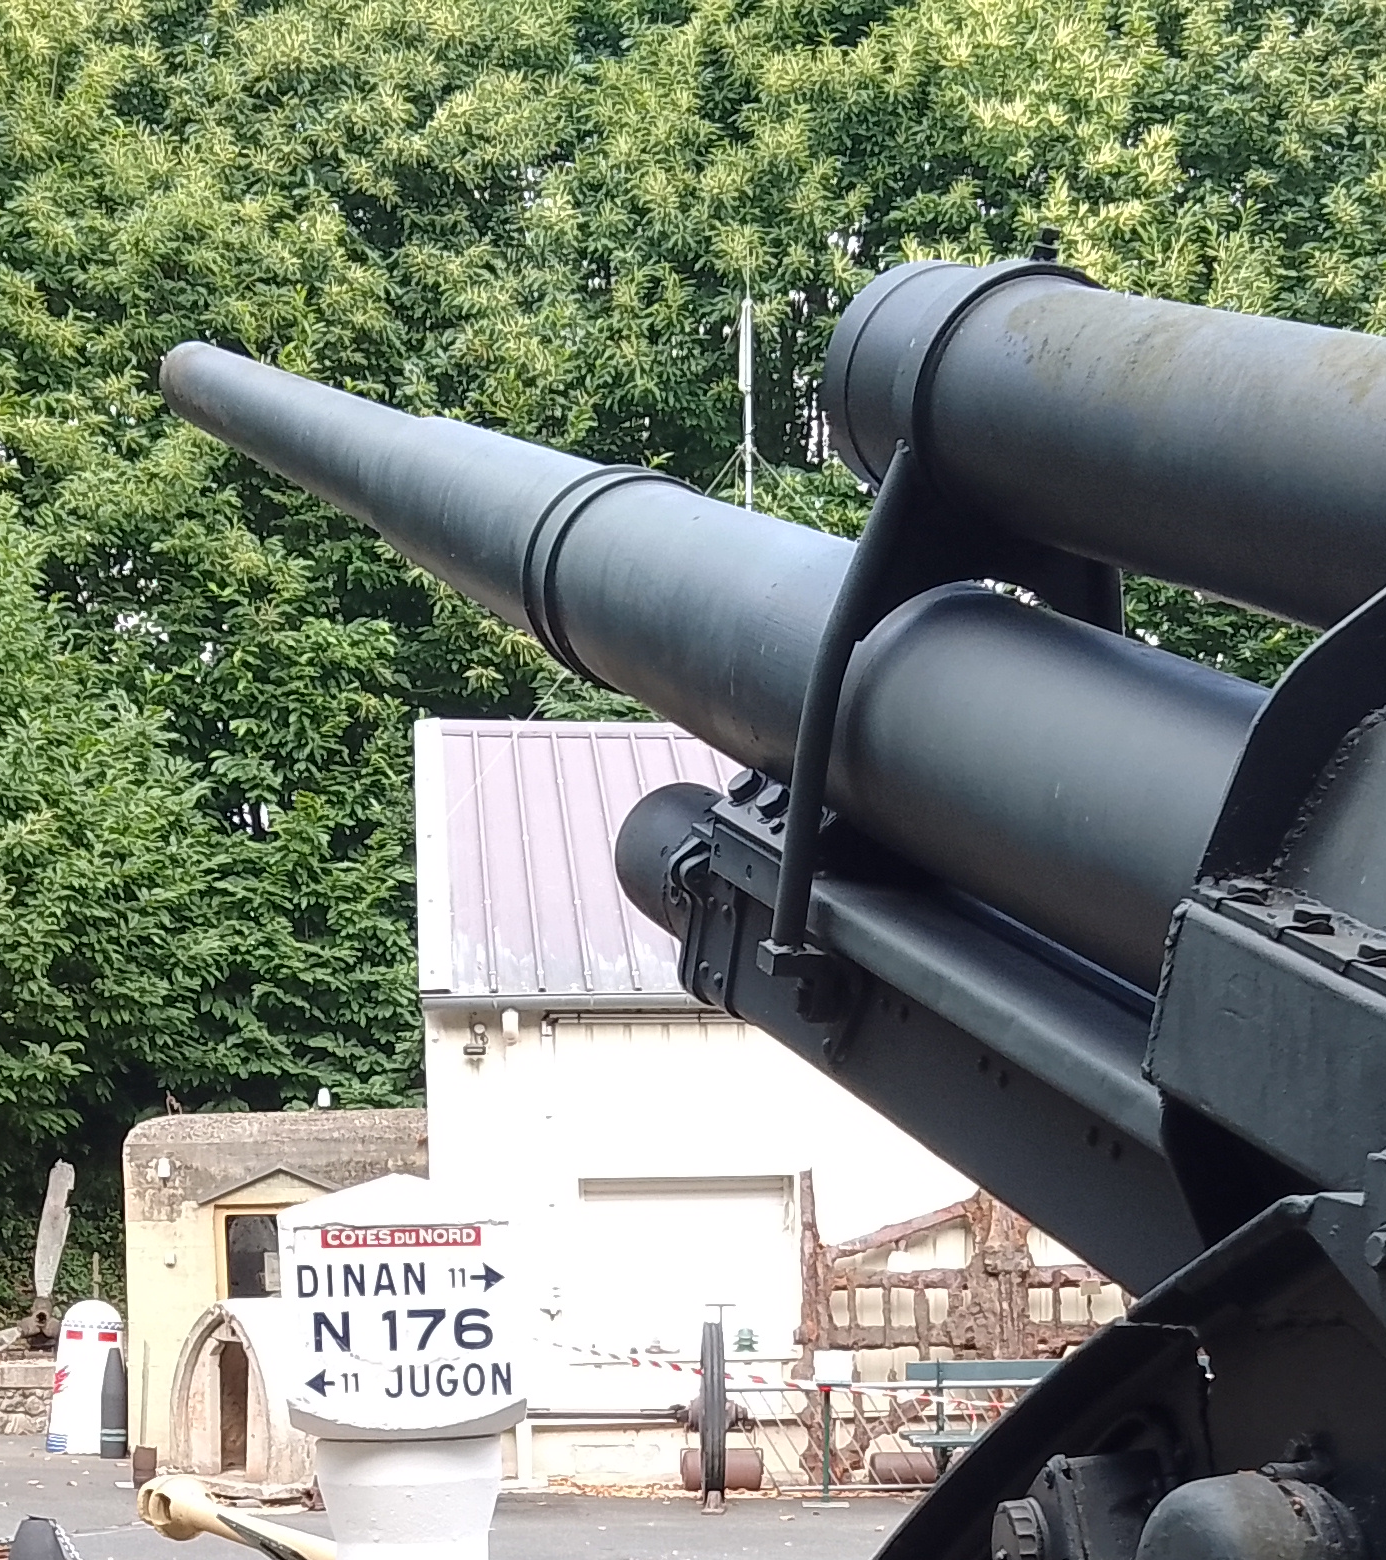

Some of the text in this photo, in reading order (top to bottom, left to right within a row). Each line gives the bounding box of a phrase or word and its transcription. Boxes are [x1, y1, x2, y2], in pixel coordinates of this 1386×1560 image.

[394, 1232, 416, 1244] DU
[419, 1229, 476, 1244] NORD
[297, 1262, 466, 1298] DINAN 11
[313, 1308, 493, 1352] N 176
[340, 1362, 512, 1398] 11 JUGON
